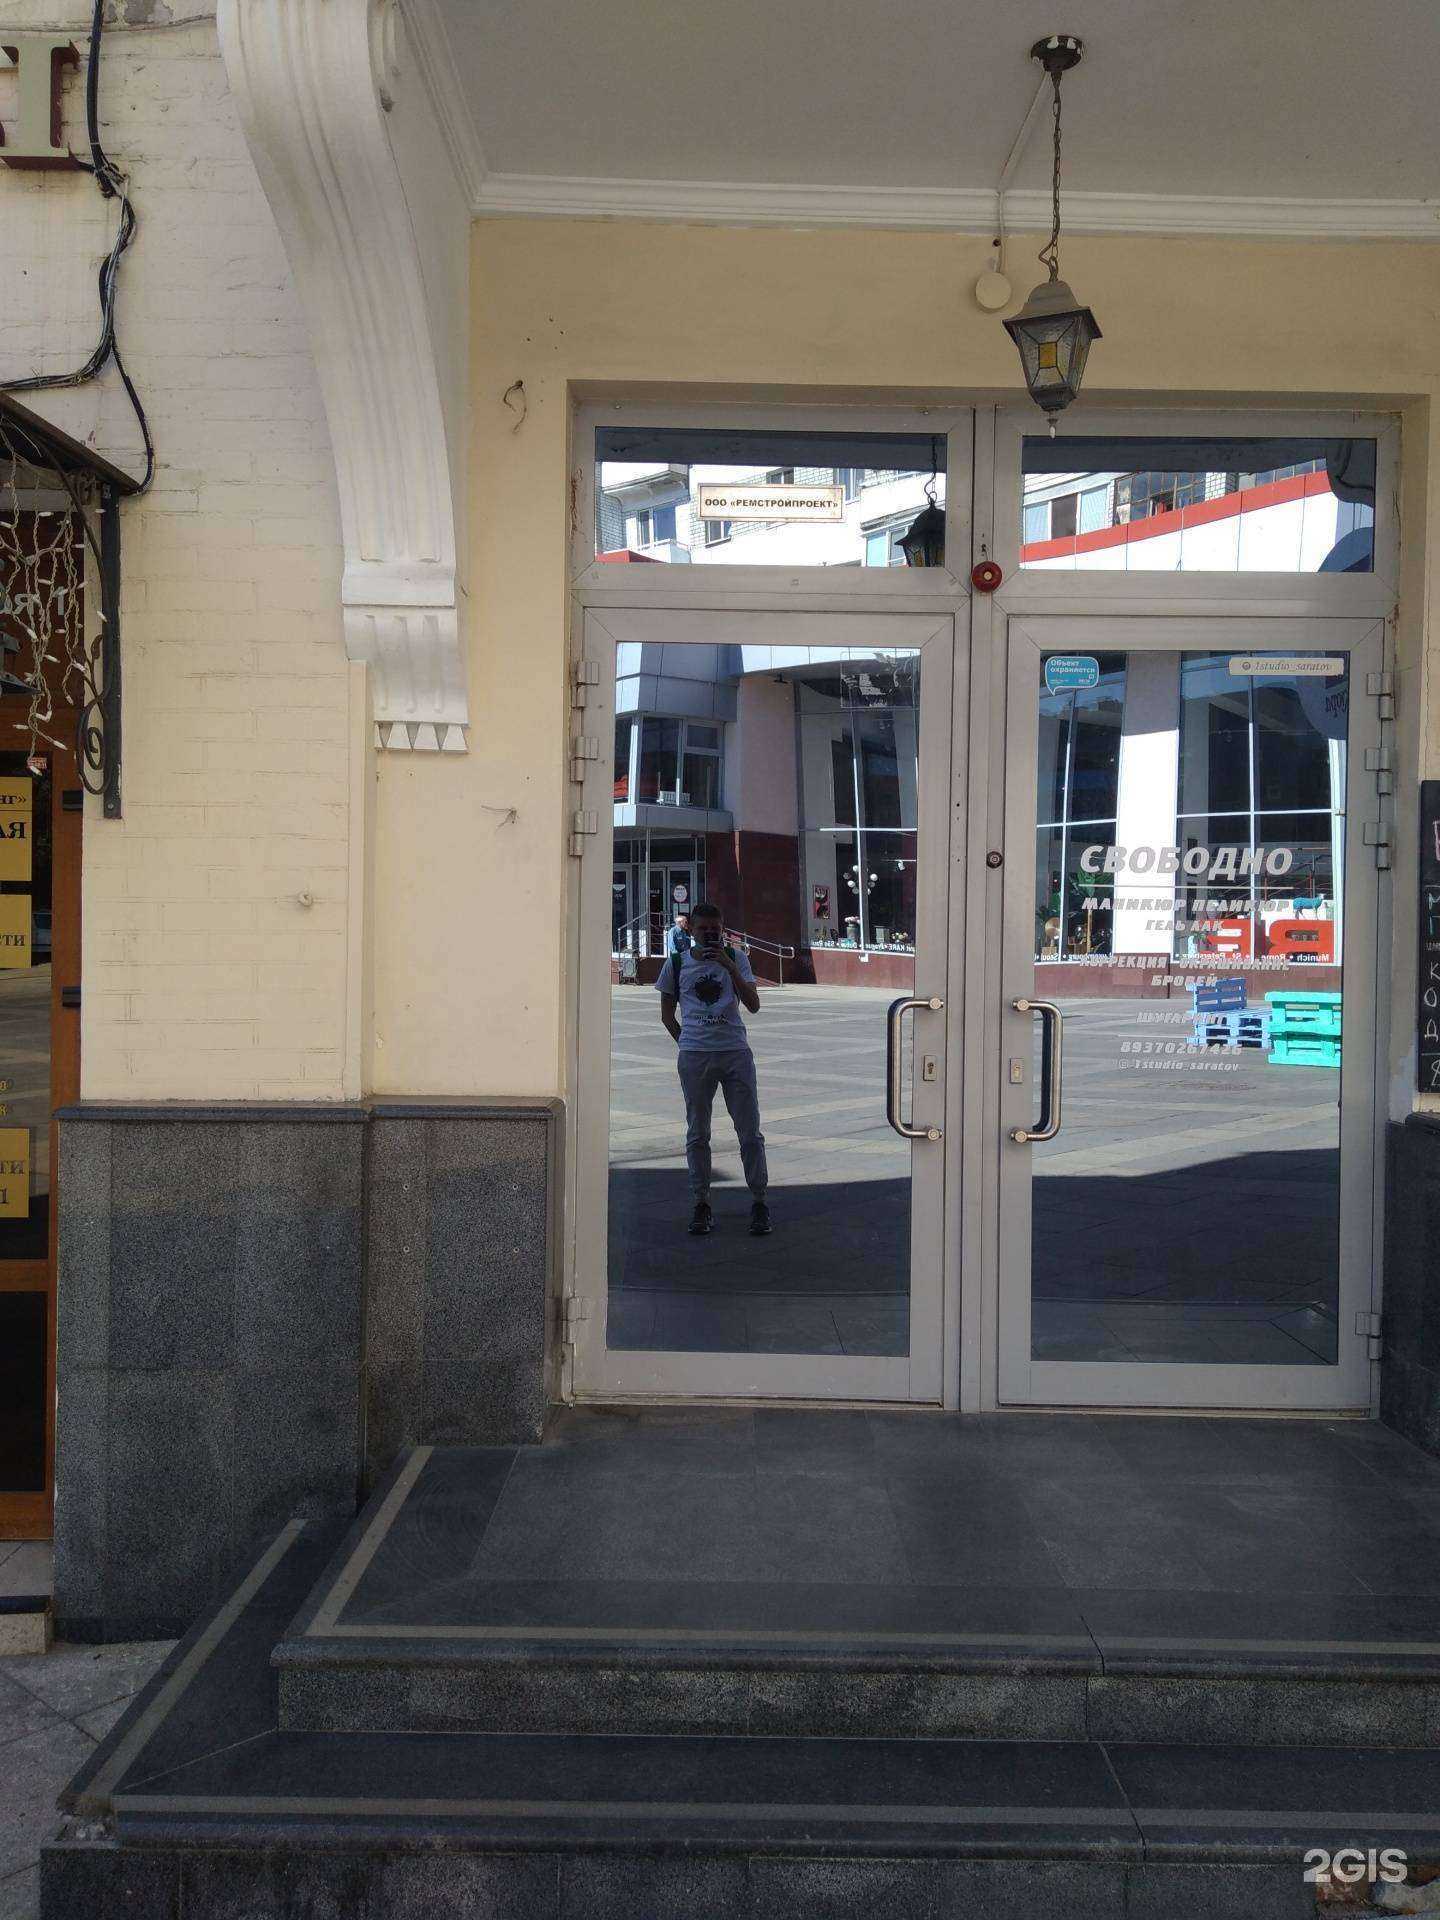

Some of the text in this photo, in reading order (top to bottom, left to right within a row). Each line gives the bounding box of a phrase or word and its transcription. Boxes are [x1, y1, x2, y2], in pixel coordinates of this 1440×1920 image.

[704, 498, 838, 508] ООО «РЕМСТРОЙПРОЕКТ»
[1080, 845, 1293, 881] СВОБОДНО
[1081, 897, 1187, 911] МАНИКЮР
[1144, 920, 1225, 932] ГЕЛЬ ЛАК
[1079, 955, 1168, 969] КОРРЕКЦИЯ
[1151, 973, 1219, 986] БРОВЕЙ
[1120, 1041, 1243, 1055] 89370267426
